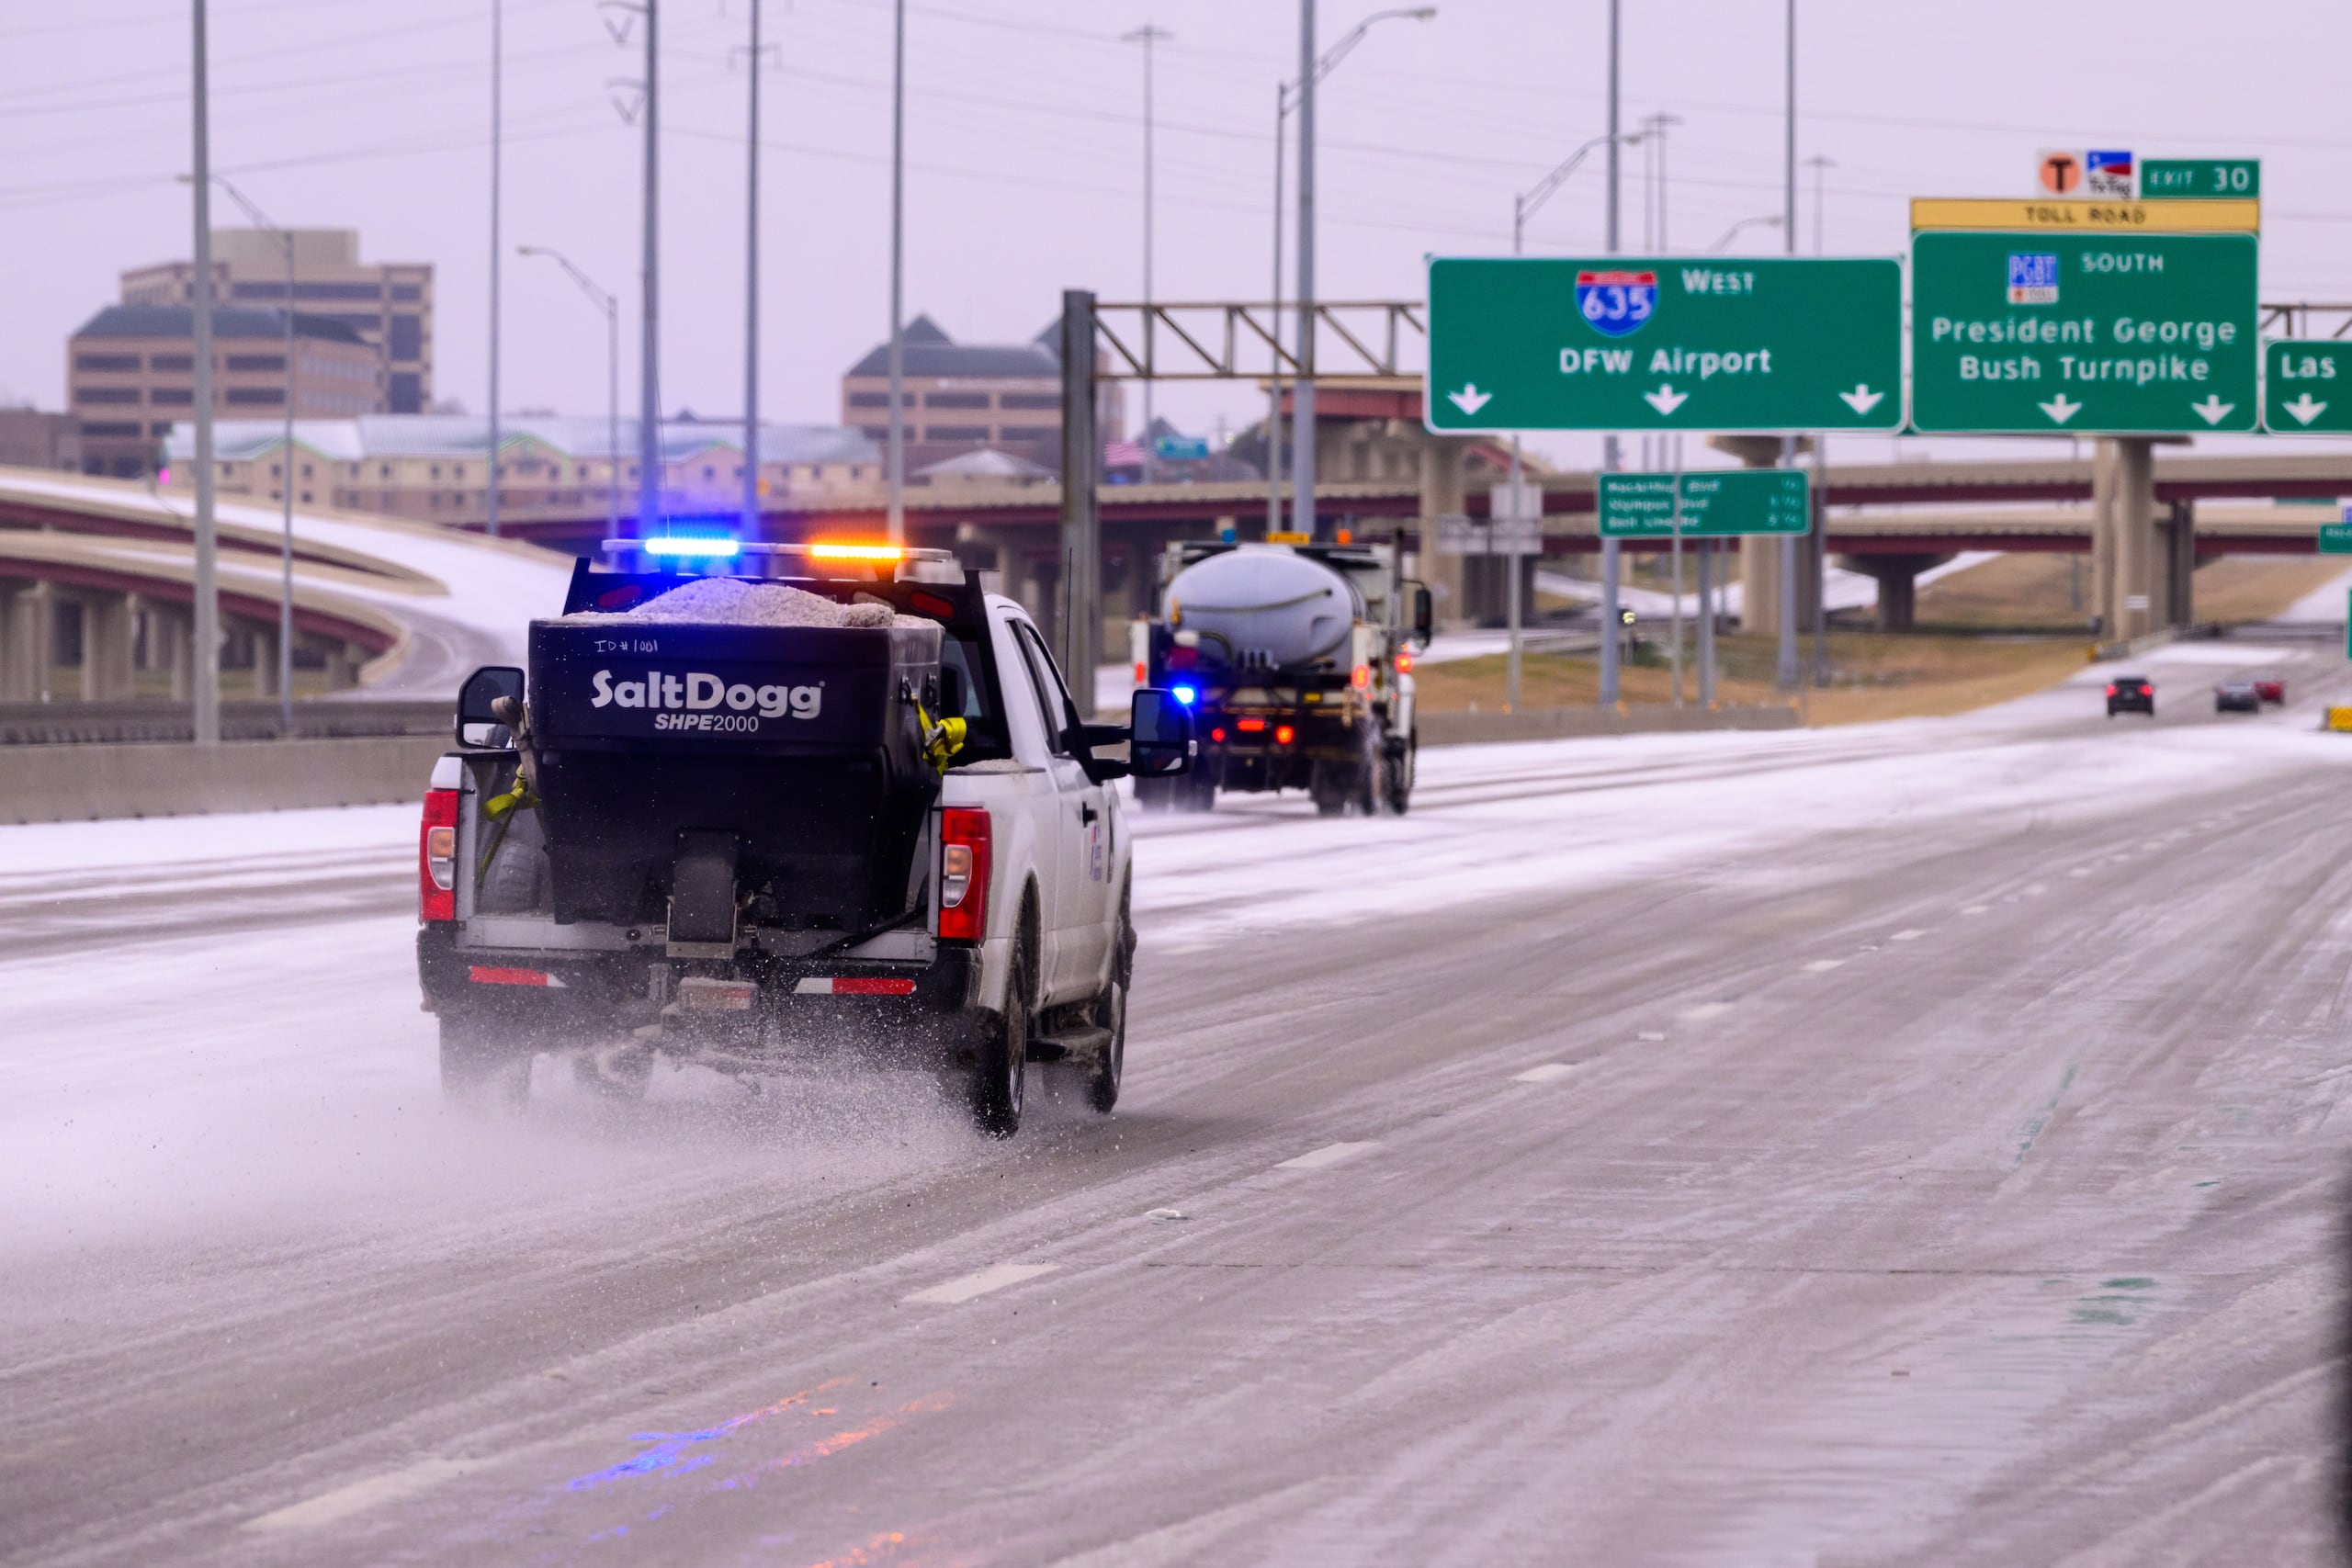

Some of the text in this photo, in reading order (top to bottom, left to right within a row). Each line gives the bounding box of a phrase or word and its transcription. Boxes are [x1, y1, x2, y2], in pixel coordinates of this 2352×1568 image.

[2150, 166, 2249, 191] EXIT 30
[2026, 207, 2147, 224] TOLL ROAD
[2081, 254, 2165, 273] SOUTH
[1583, 287, 1651, 321] 635
[1932, 317, 2237, 349] President George
[1559, 347, 1772, 379] DFW Airport
[1960, 355, 2211, 385] Bush Turnpike
[2282, 355, 2336, 378] Las
[591, 670, 822, 719] SaltDogg
[654, 713, 759, 733] SHPE2000
